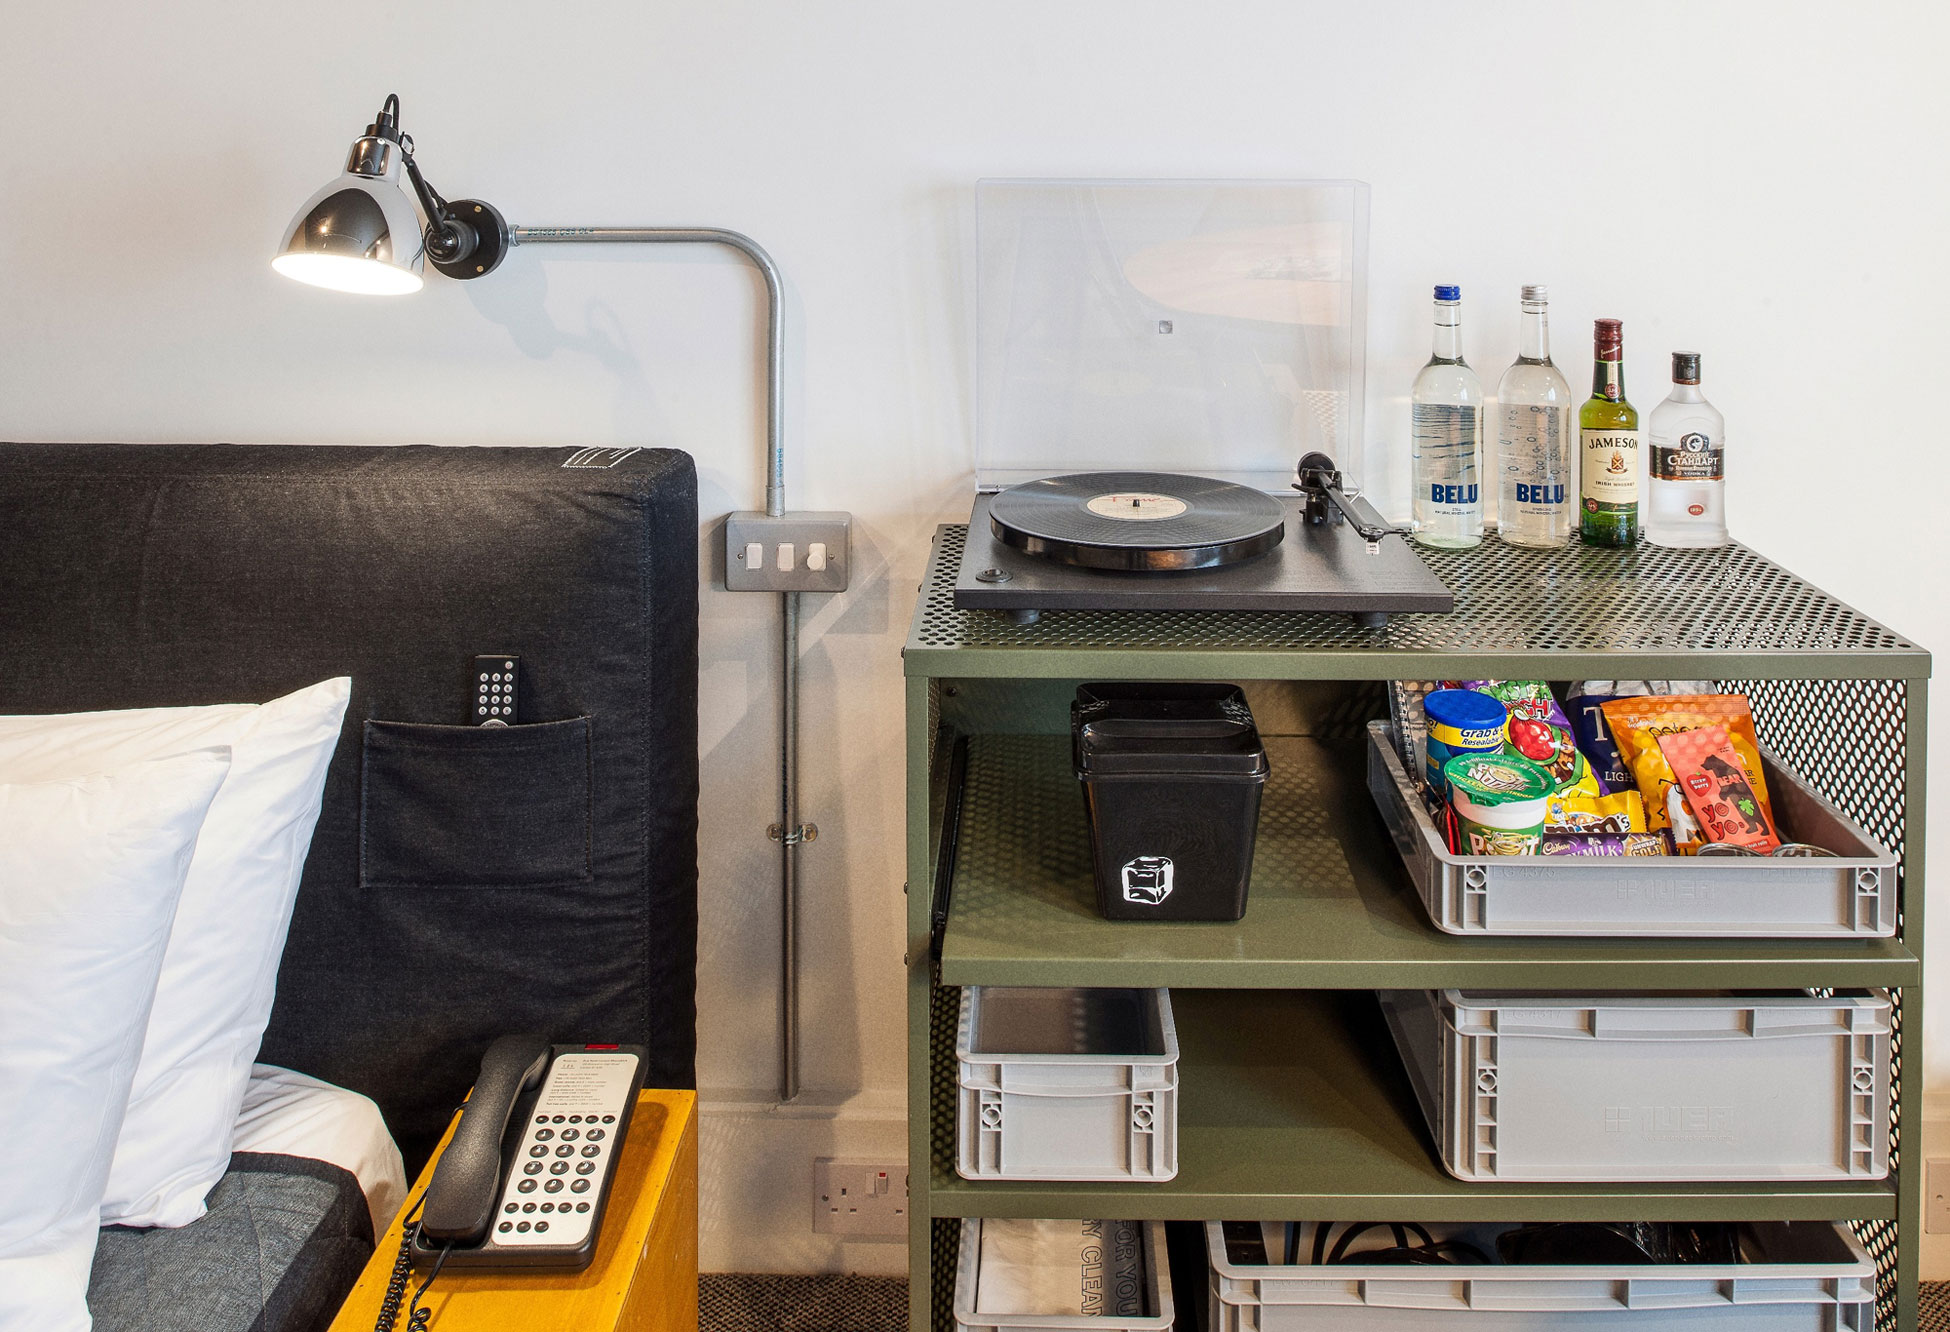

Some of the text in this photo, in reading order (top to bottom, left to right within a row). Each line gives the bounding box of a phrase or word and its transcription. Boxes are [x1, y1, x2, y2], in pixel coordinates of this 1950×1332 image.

[1589, 437, 1638, 450] JAMESON
[1431, 483, 1478, 504] BELU
[1516, 483, 1564, 504] BELU
[1461, 728, 1491, 738] Grab
[1604, 771, 1635, 783] LIGH
[1702, 803, 1729, 823] yo
[1542, 842, 1571, 856] Cadbury
